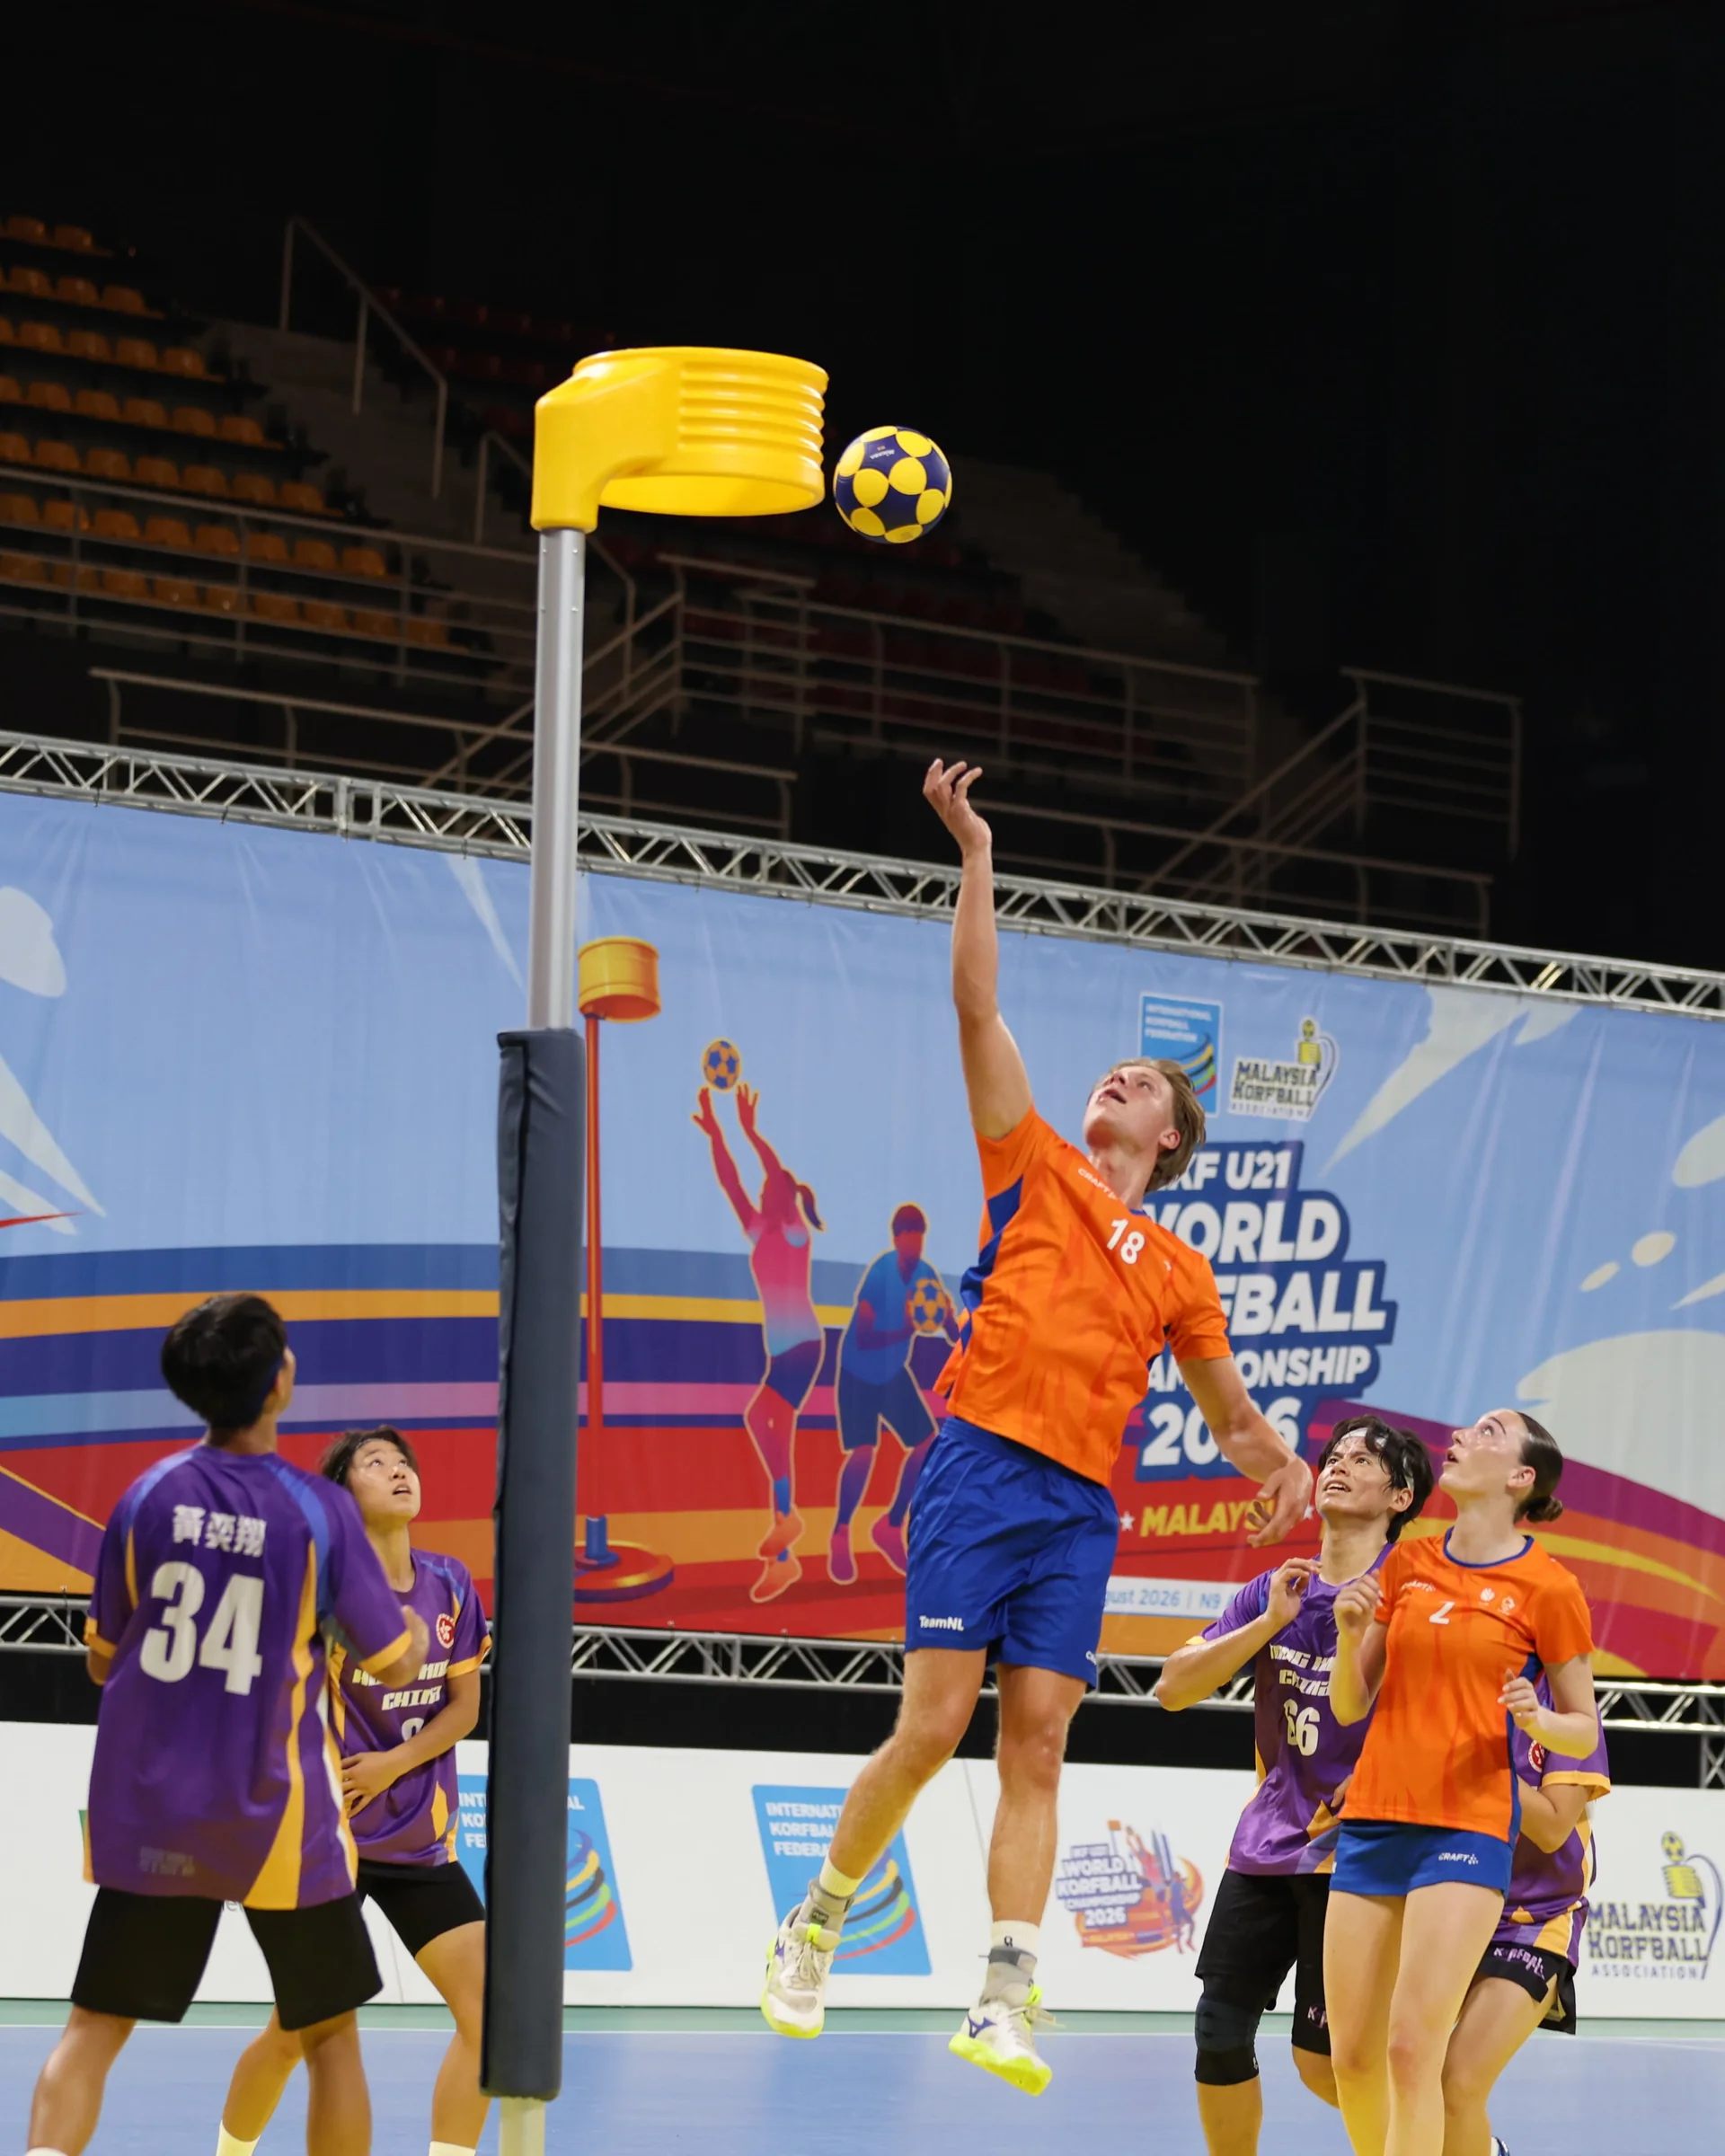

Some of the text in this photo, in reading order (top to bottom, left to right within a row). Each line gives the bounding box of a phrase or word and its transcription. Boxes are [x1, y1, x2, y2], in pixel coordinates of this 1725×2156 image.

[1235, 1061, 1317, 1087] MALAYSIA
[1233, 1081, 1314, 1107] KORFBALL
[1225, 1150, 1292, 1190] U21
[1106, 1218, 1145, 1264] 18
[1142, 1396, 1302, 1466] 206
[1139, 1589, 1181, 1607] 2026
[919, 1615, 964, 1631] TeamNL
[1429, 1601, 1455, 1625] 2
[140, 1560, 265, 1695] 34
[1438, 1852, 1469, 1862] CRAFT
[1587, 1902, 1706, 1932] MALAYSIA
[1588, 1931, 1707, 1961] KORFBALL
[1591, 1964, 1698, 1980] ASSOCIATION
